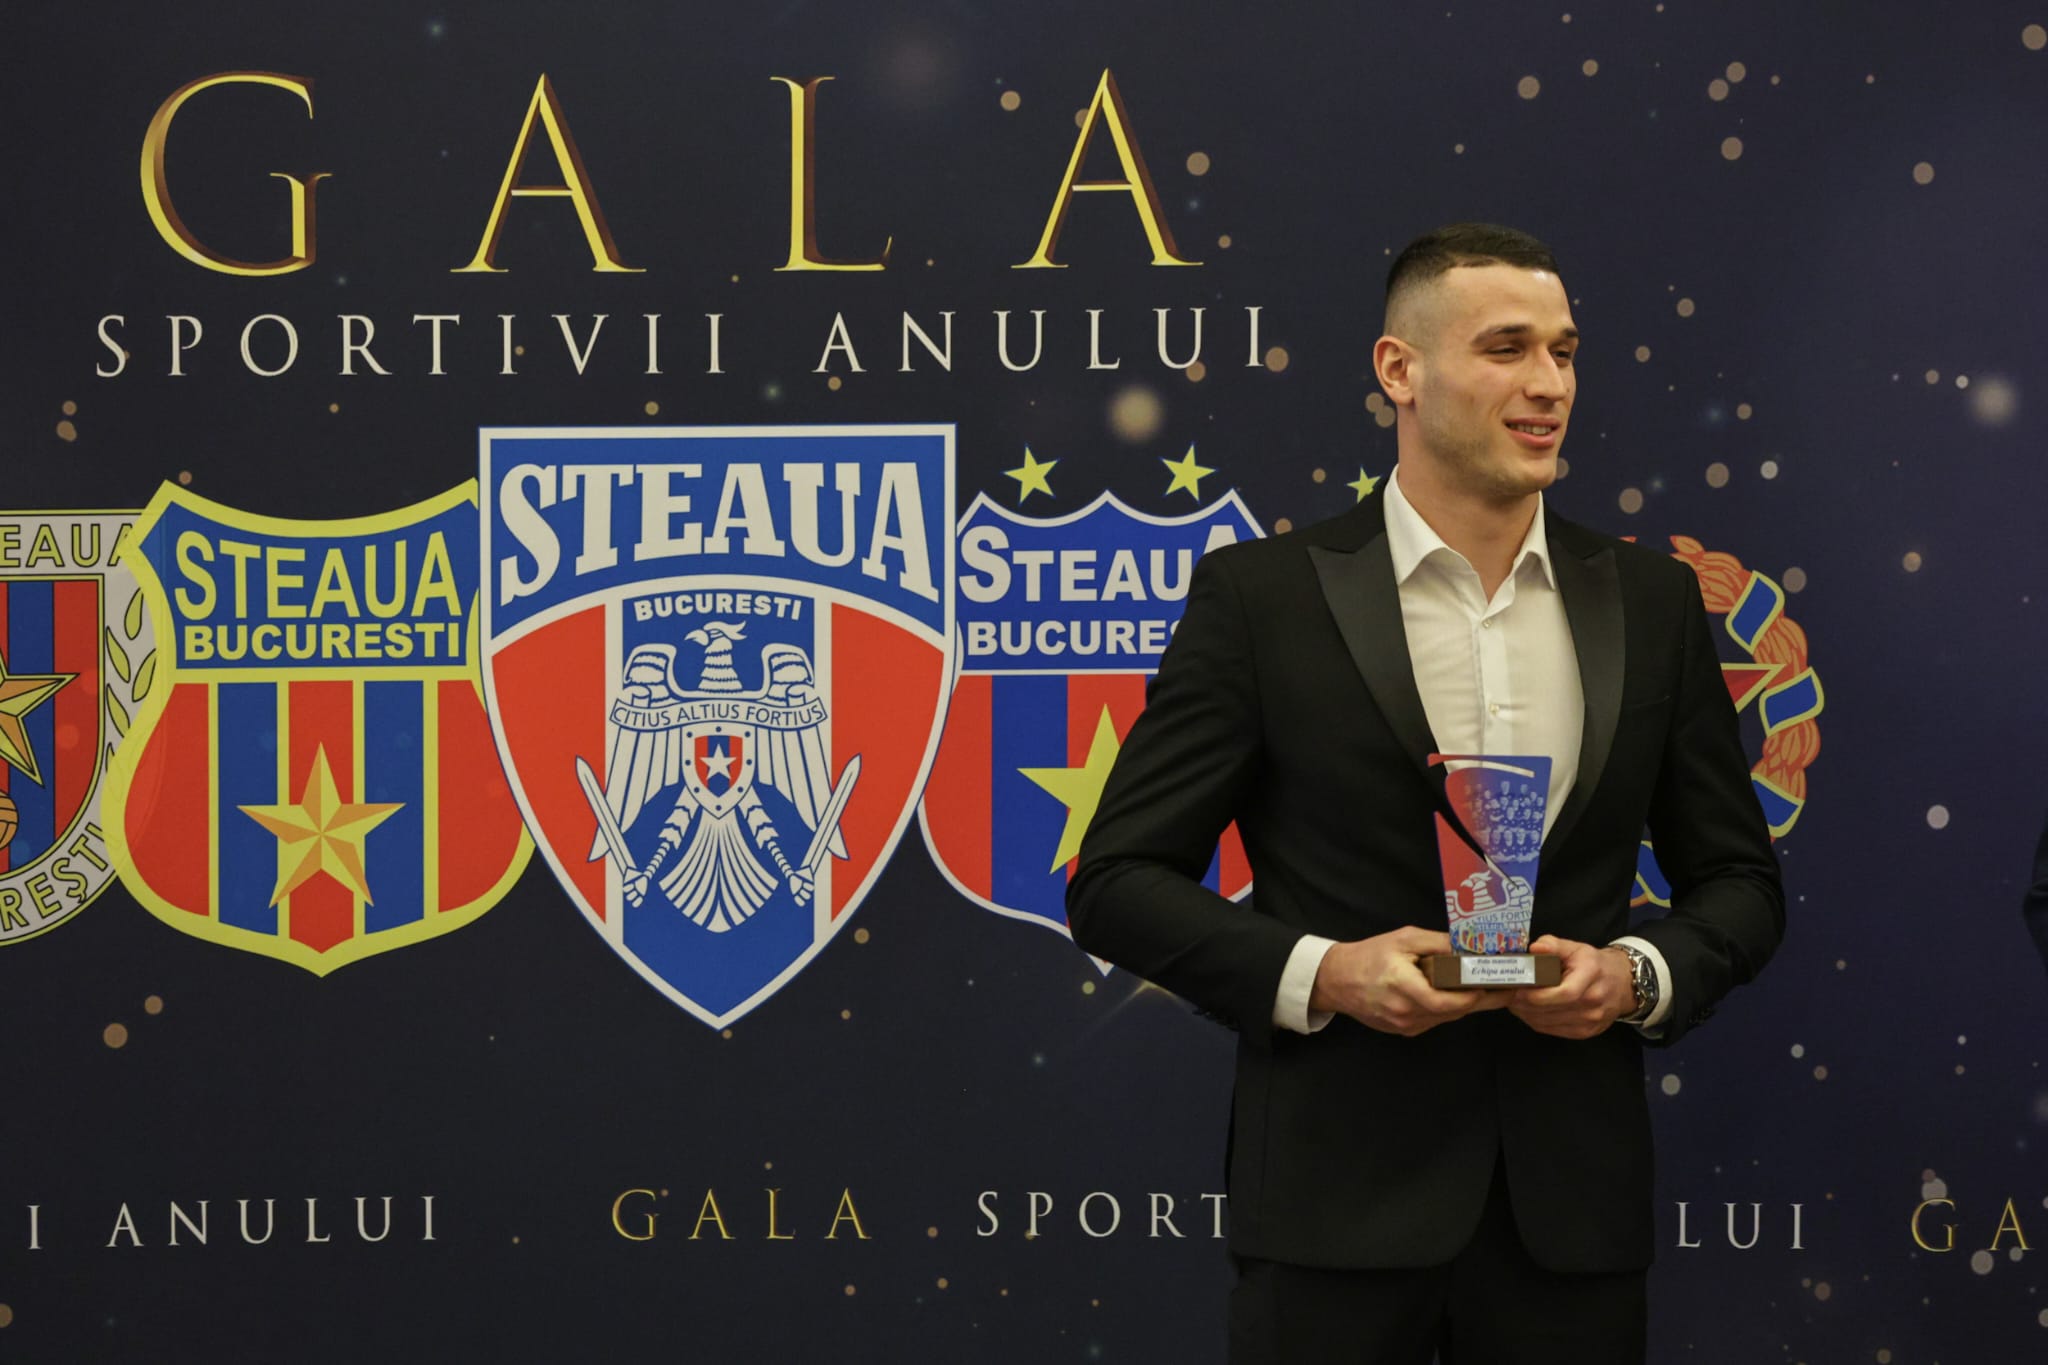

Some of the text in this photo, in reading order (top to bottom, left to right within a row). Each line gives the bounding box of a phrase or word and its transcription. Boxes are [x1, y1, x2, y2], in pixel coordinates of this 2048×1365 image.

[140, 68, 1203, 277] GALA
[96, 306, 1265, 377] SPORTIVII ANULUI
[500, 461, 940, 607] STEAUA
[174, 530, 462, 621] STEAUA
[634, 593, 802, 622] BUCURESTI
[183, 621, 460, 662] BUCURESTI
[967, 620, 1180, 656] BUCURE
[613, 703, 824, 727] CITIUS ALTIUS FORTIUS
[106, 1196, 437, 1248] ANULUI
[612, 1187, 873, 1240] GALA
[976, 1190, 1227, 1239] SPORT
[1675, 1201, 1806, 1250] LUI
[1911, 1198, 2034, 1253] GA
